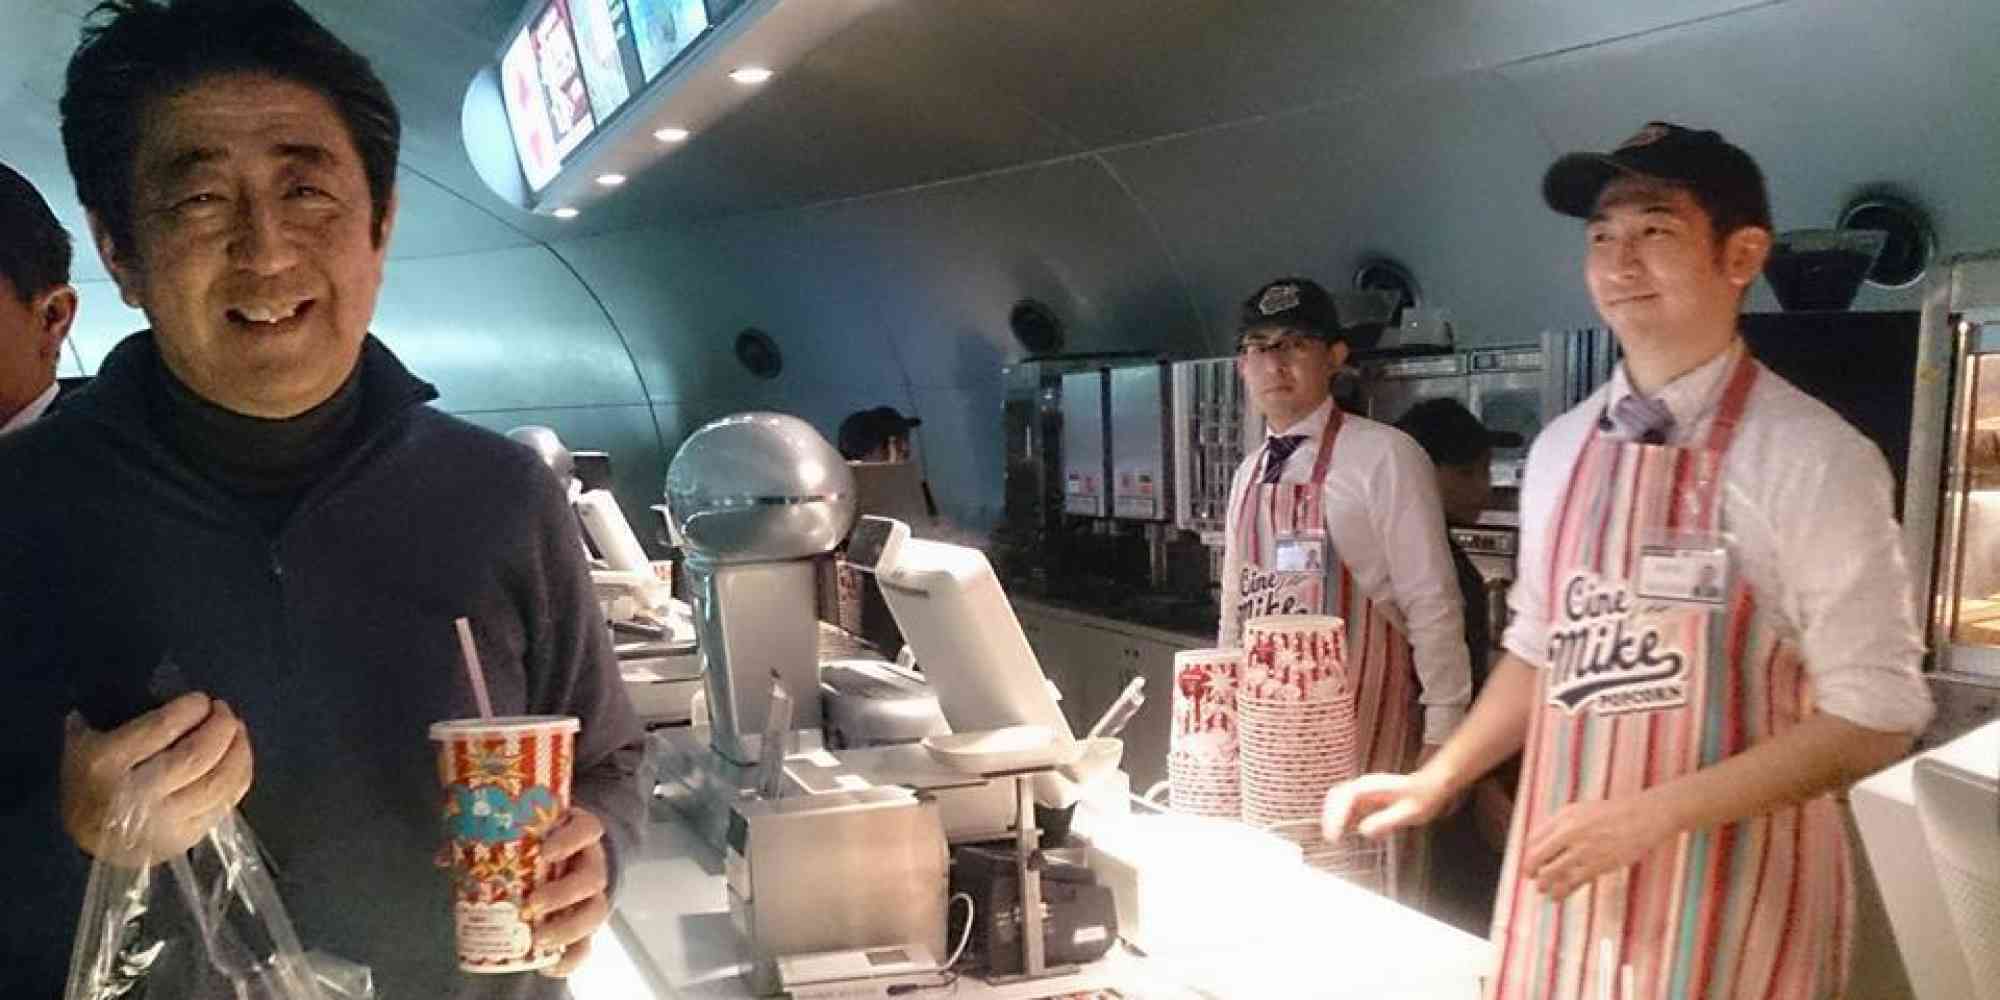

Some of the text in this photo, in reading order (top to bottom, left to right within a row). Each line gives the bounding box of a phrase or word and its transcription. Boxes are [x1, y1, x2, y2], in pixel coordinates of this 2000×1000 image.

[1240, 568, 1277, 597] Cine
[1566, 575, 1629, 621] Cine
[1549, 620, 1668, 681] Mike
